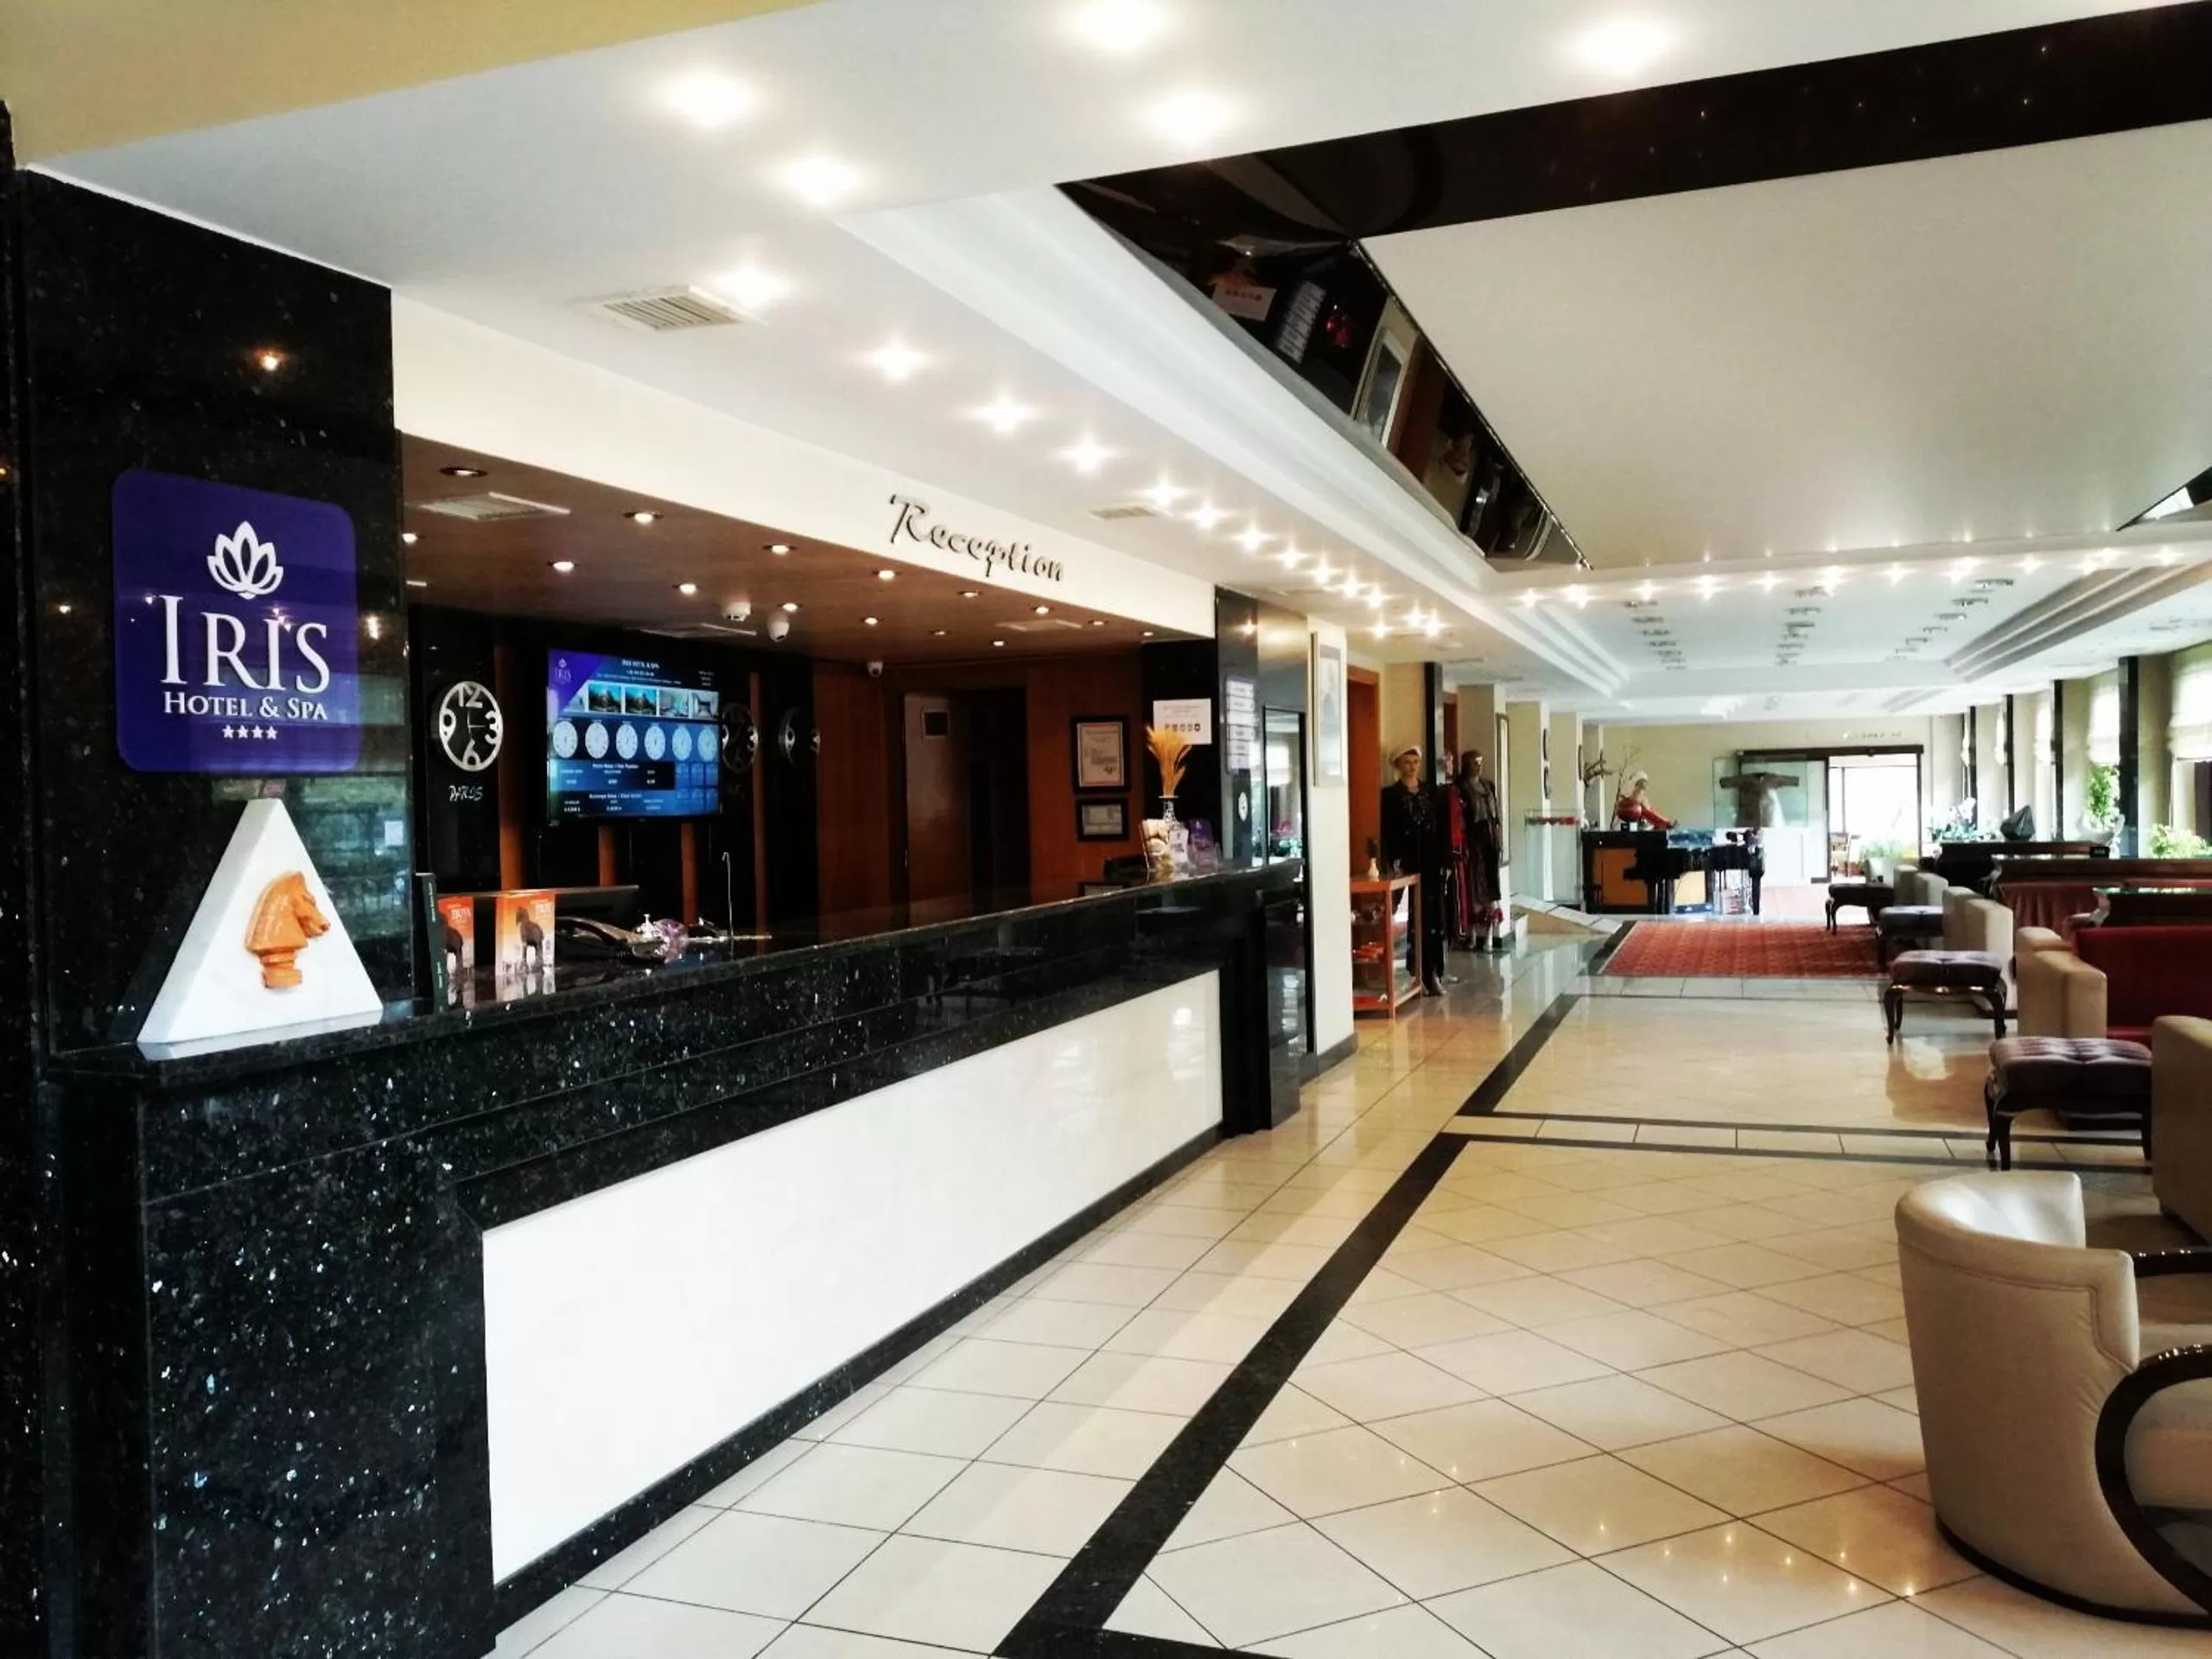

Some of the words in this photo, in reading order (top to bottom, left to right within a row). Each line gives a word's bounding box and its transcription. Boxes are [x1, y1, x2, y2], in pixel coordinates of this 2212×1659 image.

[889, 494, 1063, 582] Reception
[160, 594, 330, 694] IRIS
[258, 696, 280, 718] &
